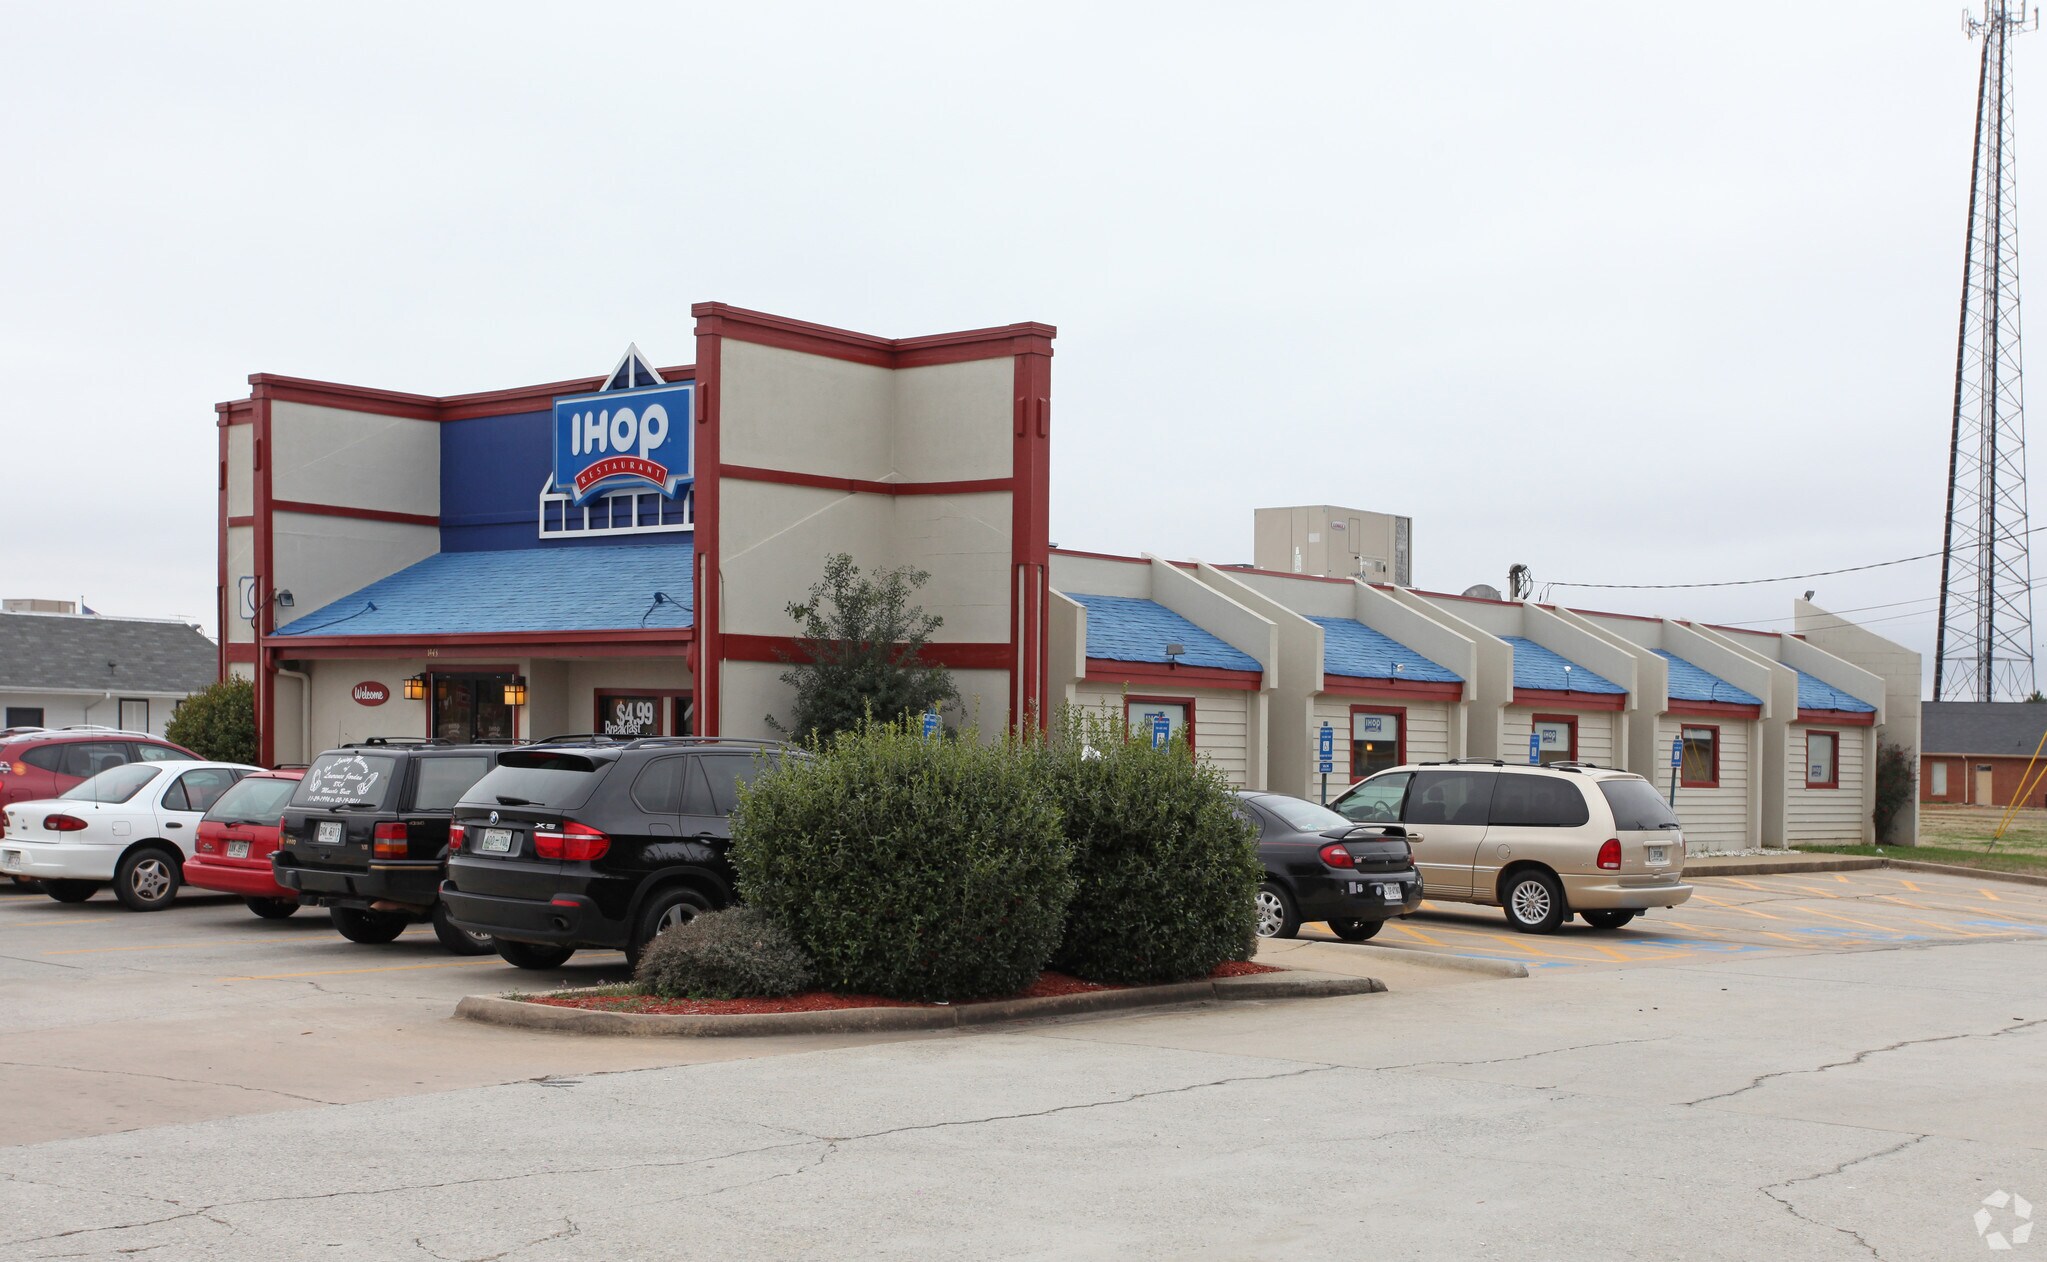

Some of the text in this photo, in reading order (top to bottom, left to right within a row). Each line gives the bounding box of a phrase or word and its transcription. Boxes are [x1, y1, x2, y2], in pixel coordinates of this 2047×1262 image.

[572, 404, 669, 460] IHOP
[581, 461, 661, 484] RESTAURANT
[354, 685, 384, 700] Welcome
[616, 701, 653, 727] $4.99
[605, 719, 640, 735] Breakfast
